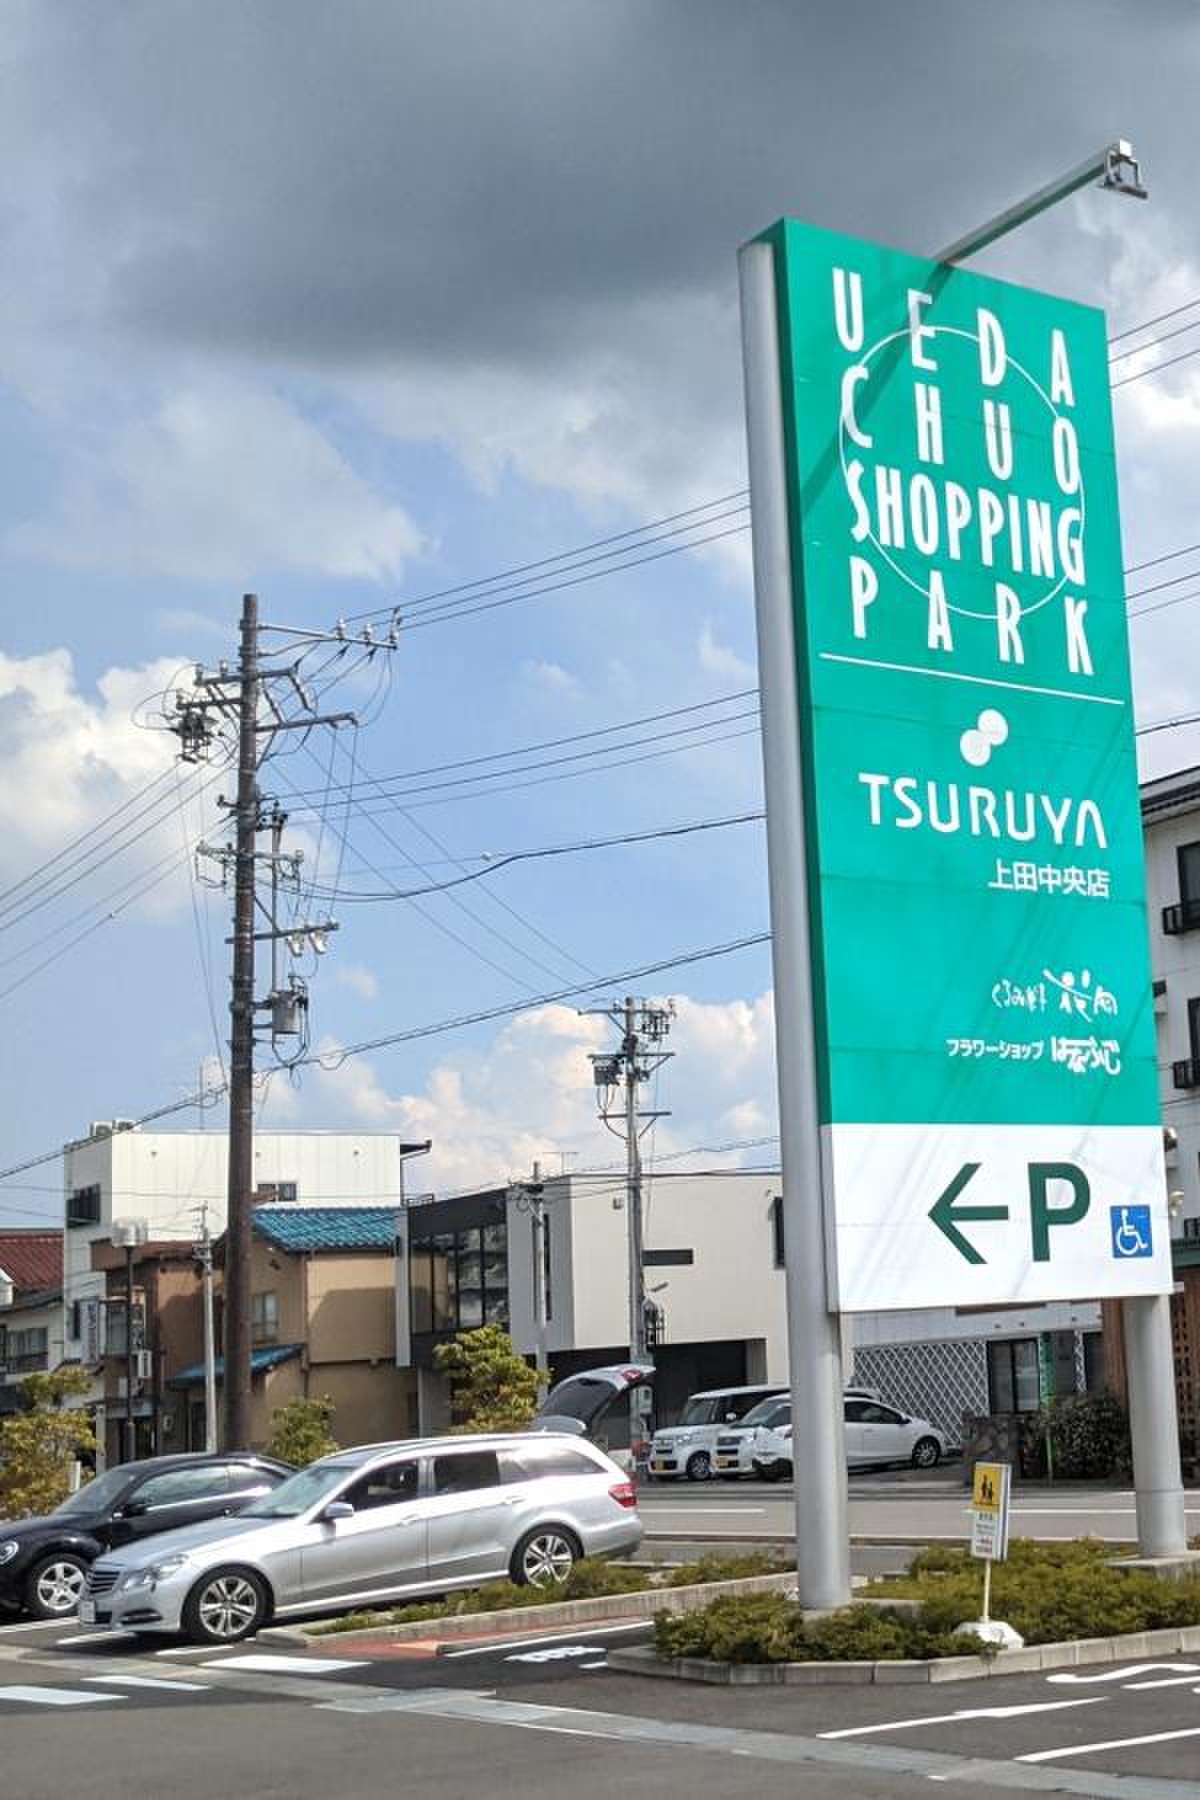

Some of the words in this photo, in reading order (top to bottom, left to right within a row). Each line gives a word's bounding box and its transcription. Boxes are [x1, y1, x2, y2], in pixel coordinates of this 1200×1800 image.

[832, 268, 1075, 407] UEDA
[841, 364, 1080, 495] CHUO
[847, 459, 1086, 586] SHOPPING
[850, 556, 1094, 676] PARK
[858, 772, 1108, 849] TSURUYA
[988, 858, 1111, 898] 上田中央店
[945, 1039, 1044, 1060] フラワーショップ
[1028, 1162, 1091, 1263] P
